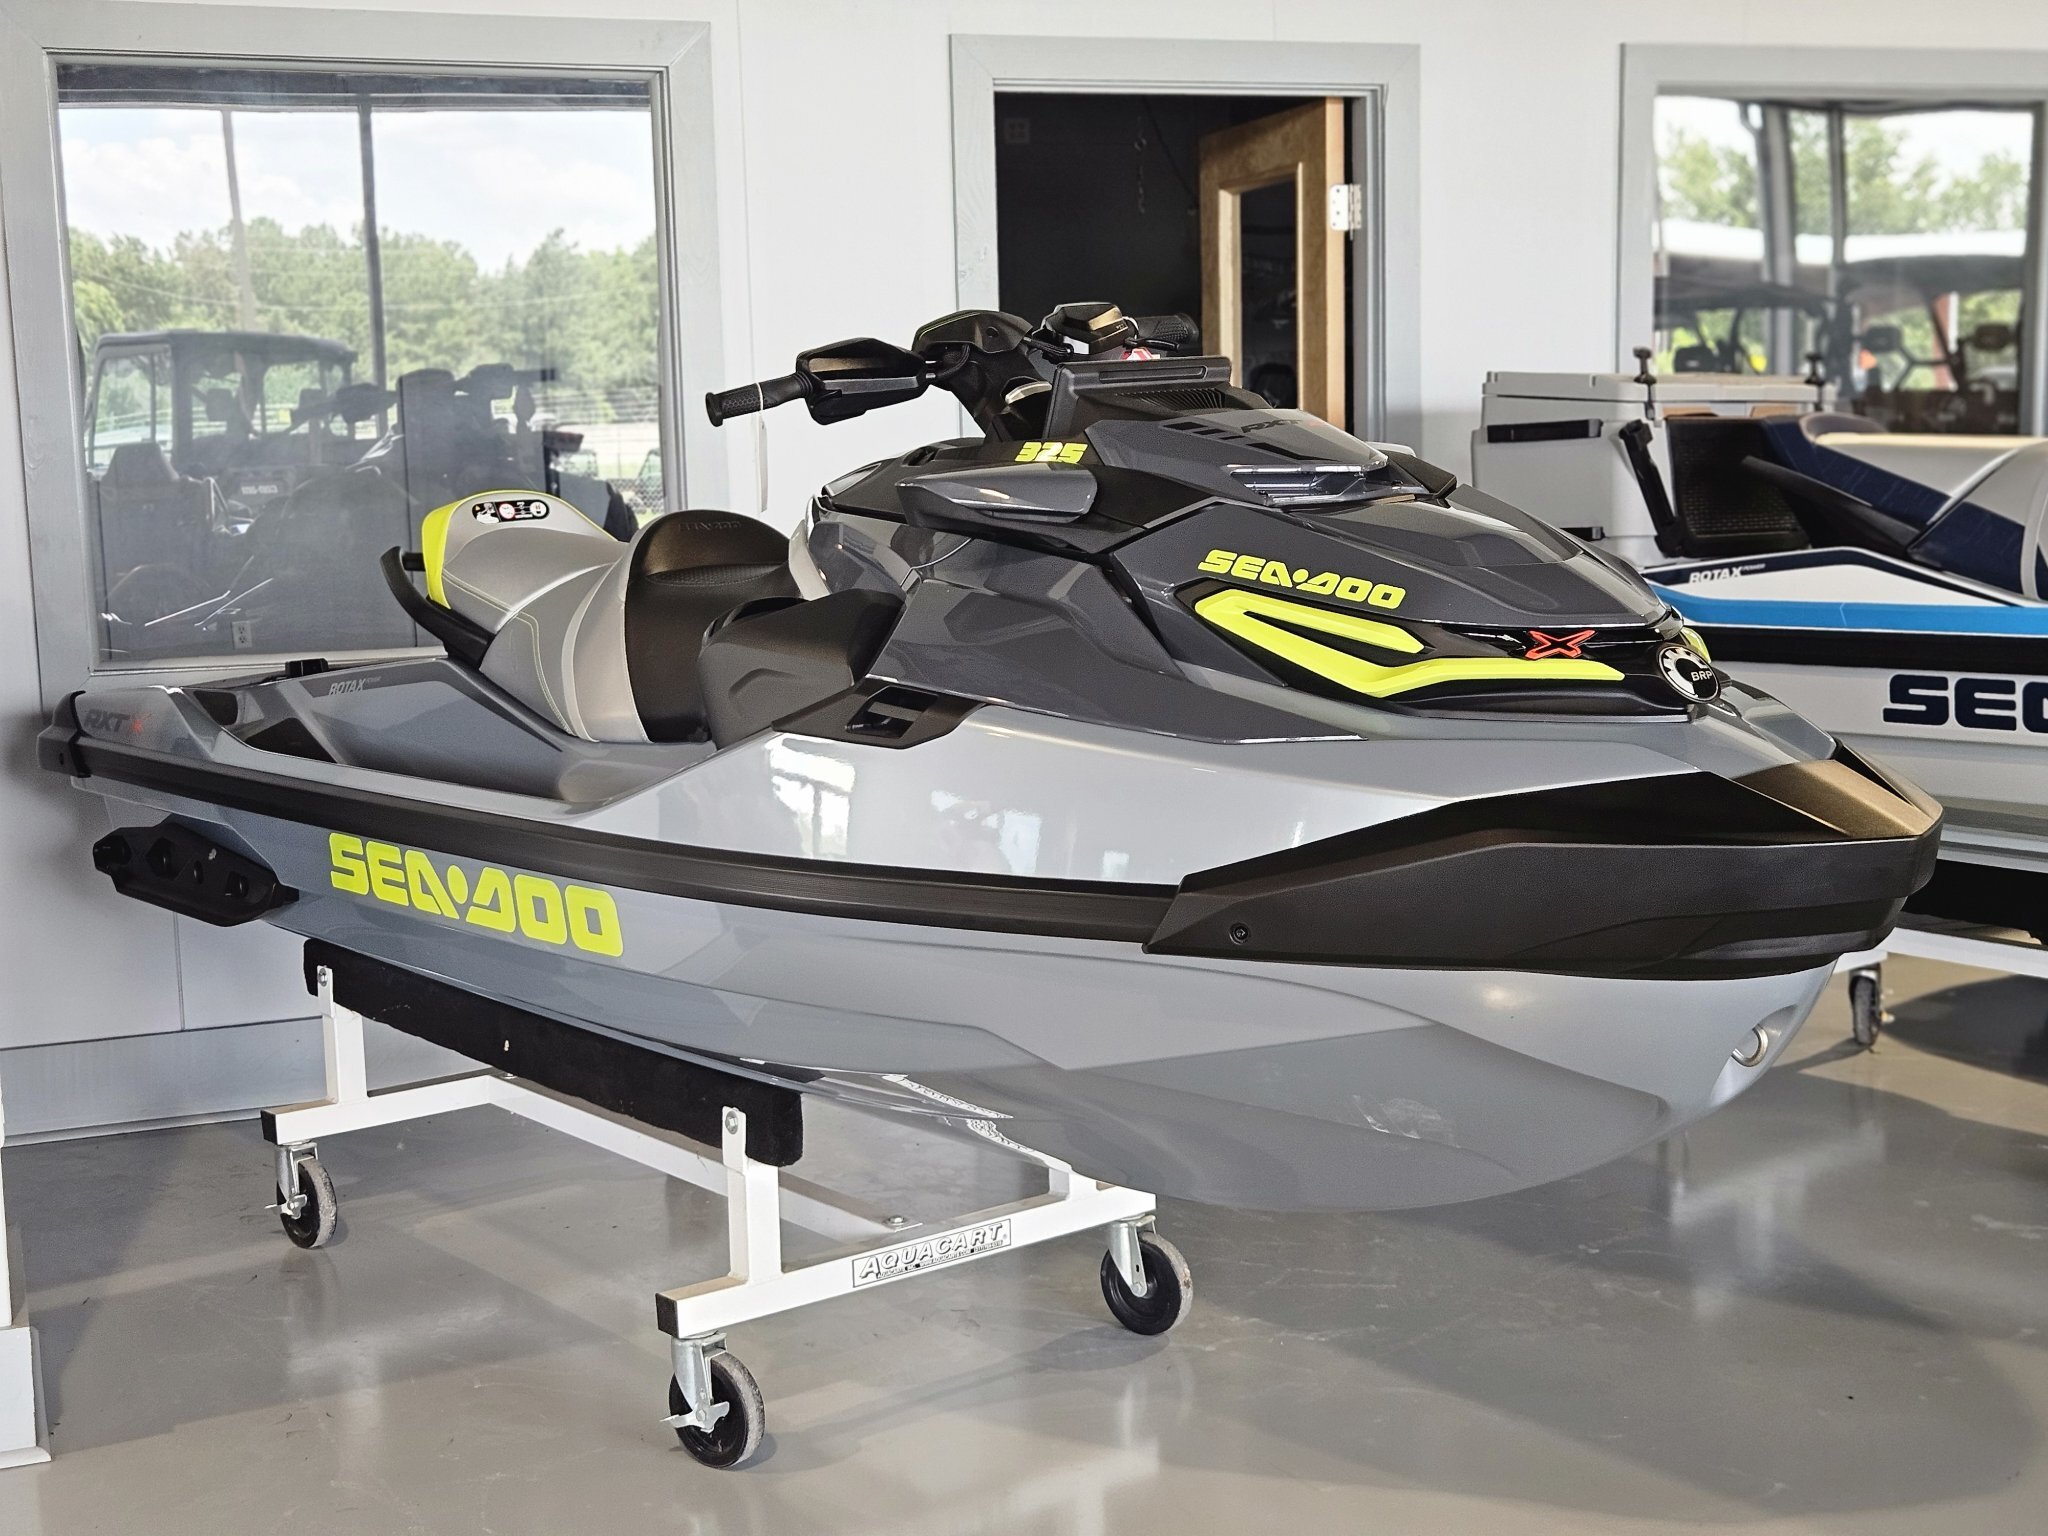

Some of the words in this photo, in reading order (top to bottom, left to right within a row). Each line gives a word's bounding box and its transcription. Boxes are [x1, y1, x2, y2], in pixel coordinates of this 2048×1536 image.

[1014, 441, 1089, 464] 325
[1688, 567, 1741, 584] ROTAX
[1690, 670, 1714, 682] BRP
[328, 678, 366, 696] ROTAX
[84, 709, 131, 732] RXT
[859, 1223, 1003, 1279] AQUACART
